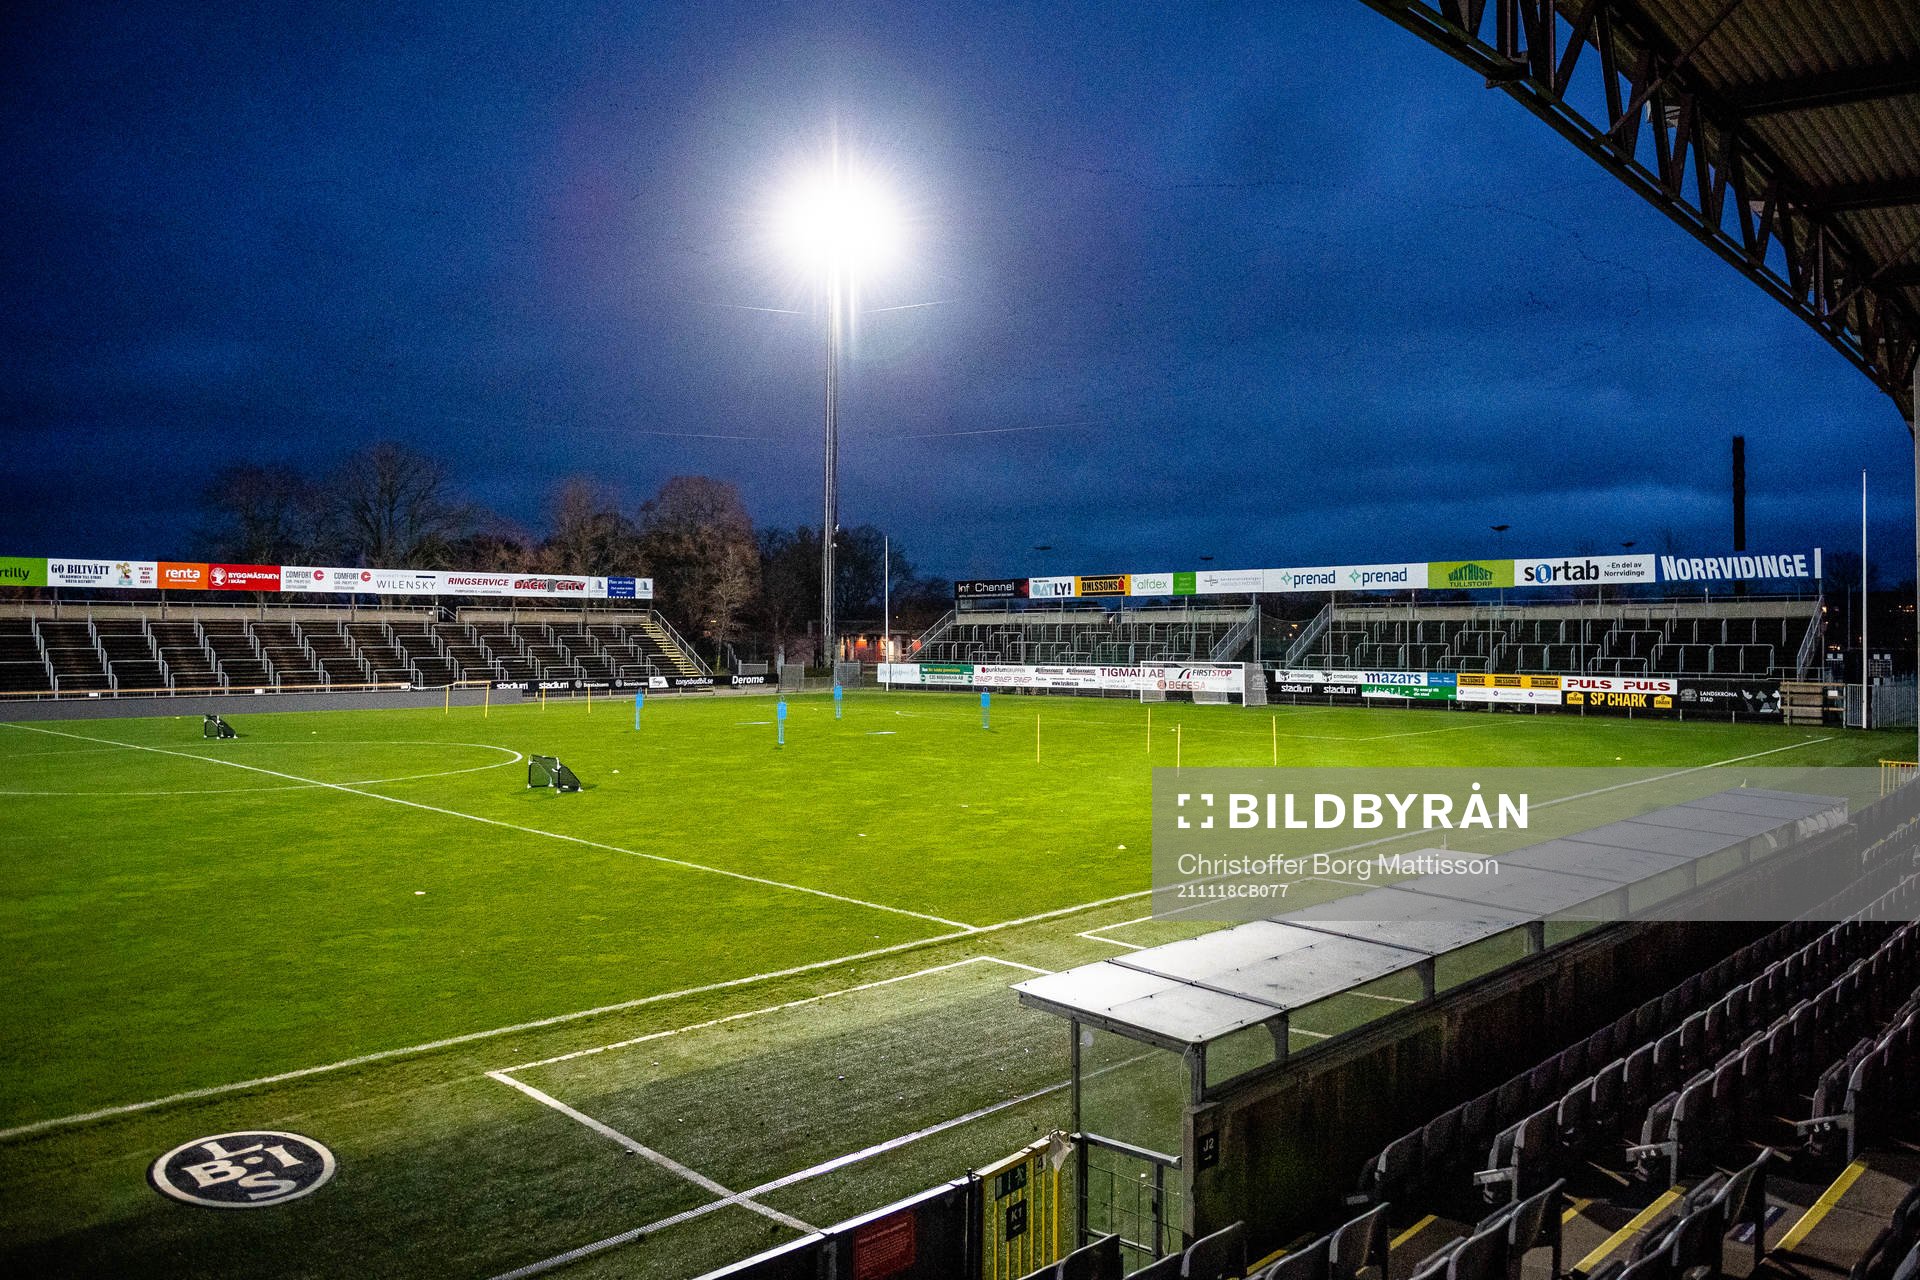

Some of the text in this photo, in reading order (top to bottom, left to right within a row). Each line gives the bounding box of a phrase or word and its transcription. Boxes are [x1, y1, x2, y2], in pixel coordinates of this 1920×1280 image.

[67, 563, 110, 576] BILTVÄTT
[1524, 560, 1599, 583] sortab
[1661, 554, 1809, 581] NORRVIDINGE
[165, 568, 201, 579] renta
[285, 570, 312, 579] COMFORT
[333, 572, 359, 580] COMFORT
[1293, 570, 1336, 588] prenad
[1362, 567, 1407, 587] prenad
[1604, 569, 1645, 578] Norrvidinge
[376, 580, 437, 590] WILENSKY
[447, 577, 510, 587] RINGSERVICE
[556, 580, 586, 591] CITY
[1137, 577, 1168, 590] alfdex
[1100, 667, 1145, 678] TIGMAN
[1149, 668, 1165, 678] AB
[732, 675, 765, 685] Derome
[1365, 672, 1422, 685] mazars
[496, 681, 569, 690] stadium stadium
[1168, 679, 1206, 690] BEFESA
[1280, 684, 1357, 694] stadium stadium
[1567, 679, 1671, 691] PULS PULS
[1700, 690, 1738, 698] LANDSKRONA
[1590, 692, 1647, 708] SP CHARK
